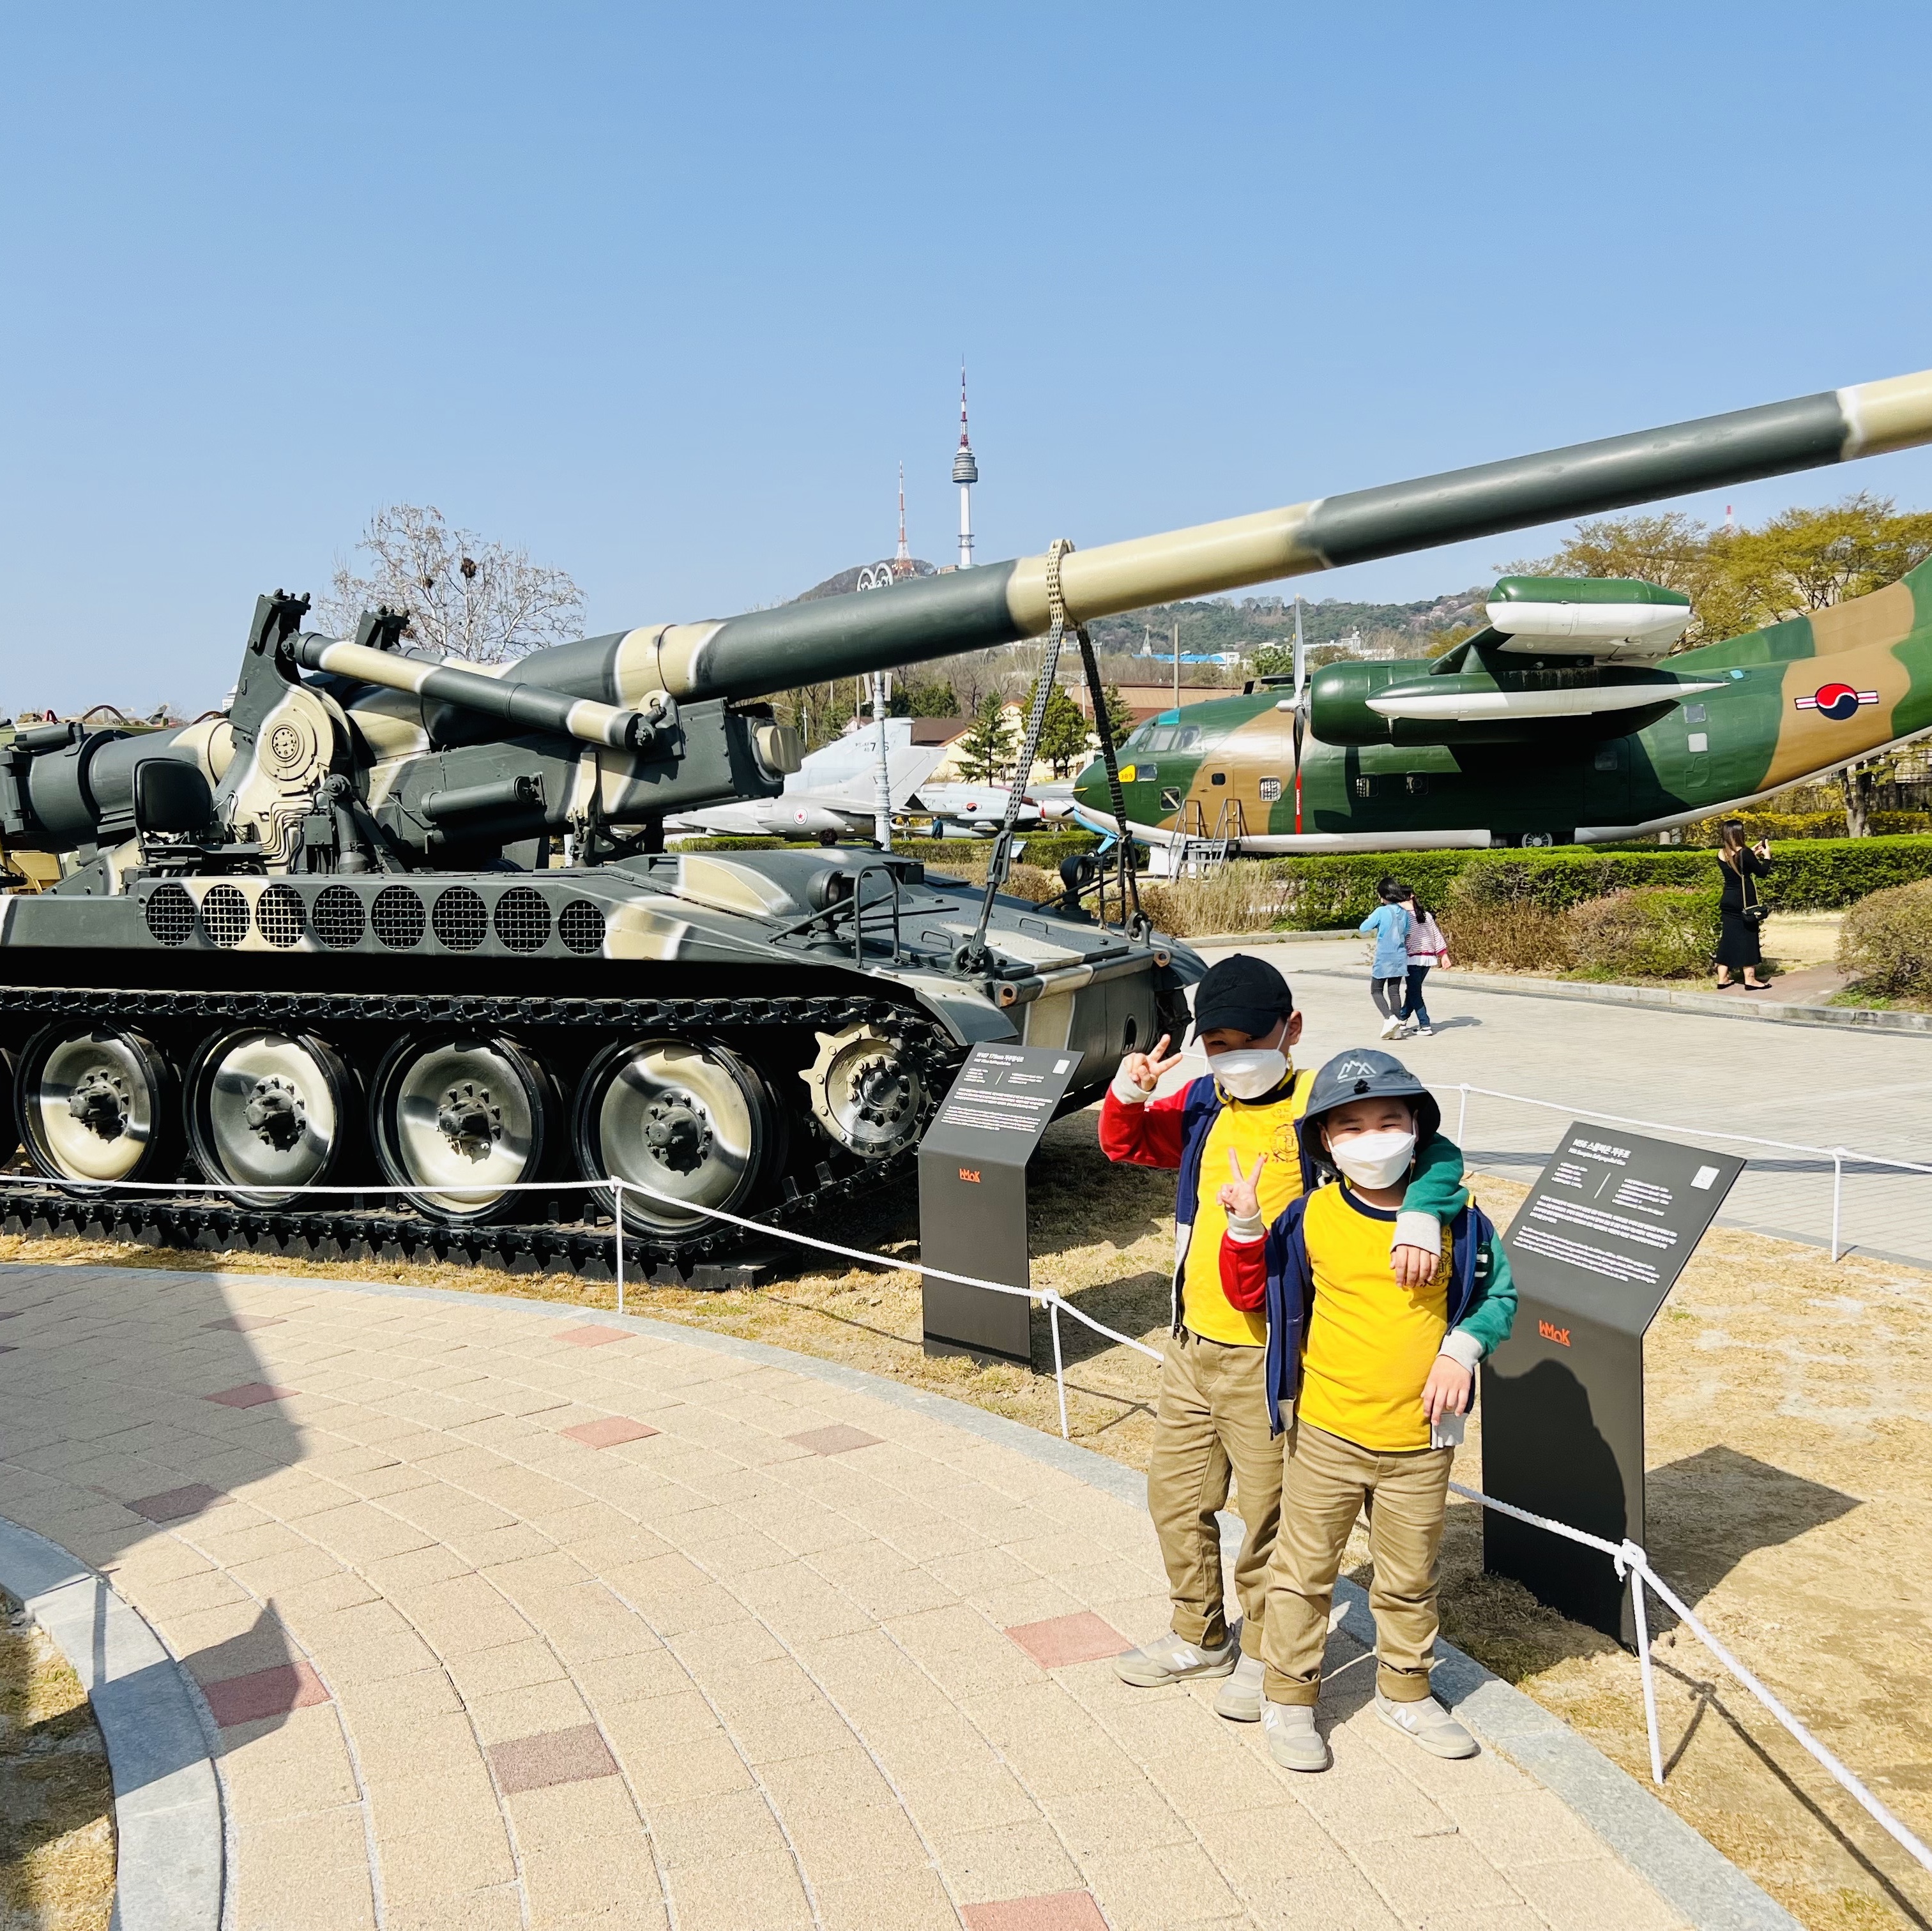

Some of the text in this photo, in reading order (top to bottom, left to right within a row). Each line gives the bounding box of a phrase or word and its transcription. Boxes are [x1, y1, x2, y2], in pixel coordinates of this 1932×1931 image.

[1171, 1649, 1200, 1670] N
[1263, 1709, 1279, 1732] N
[1393, 1707, 1418, 1728] N
